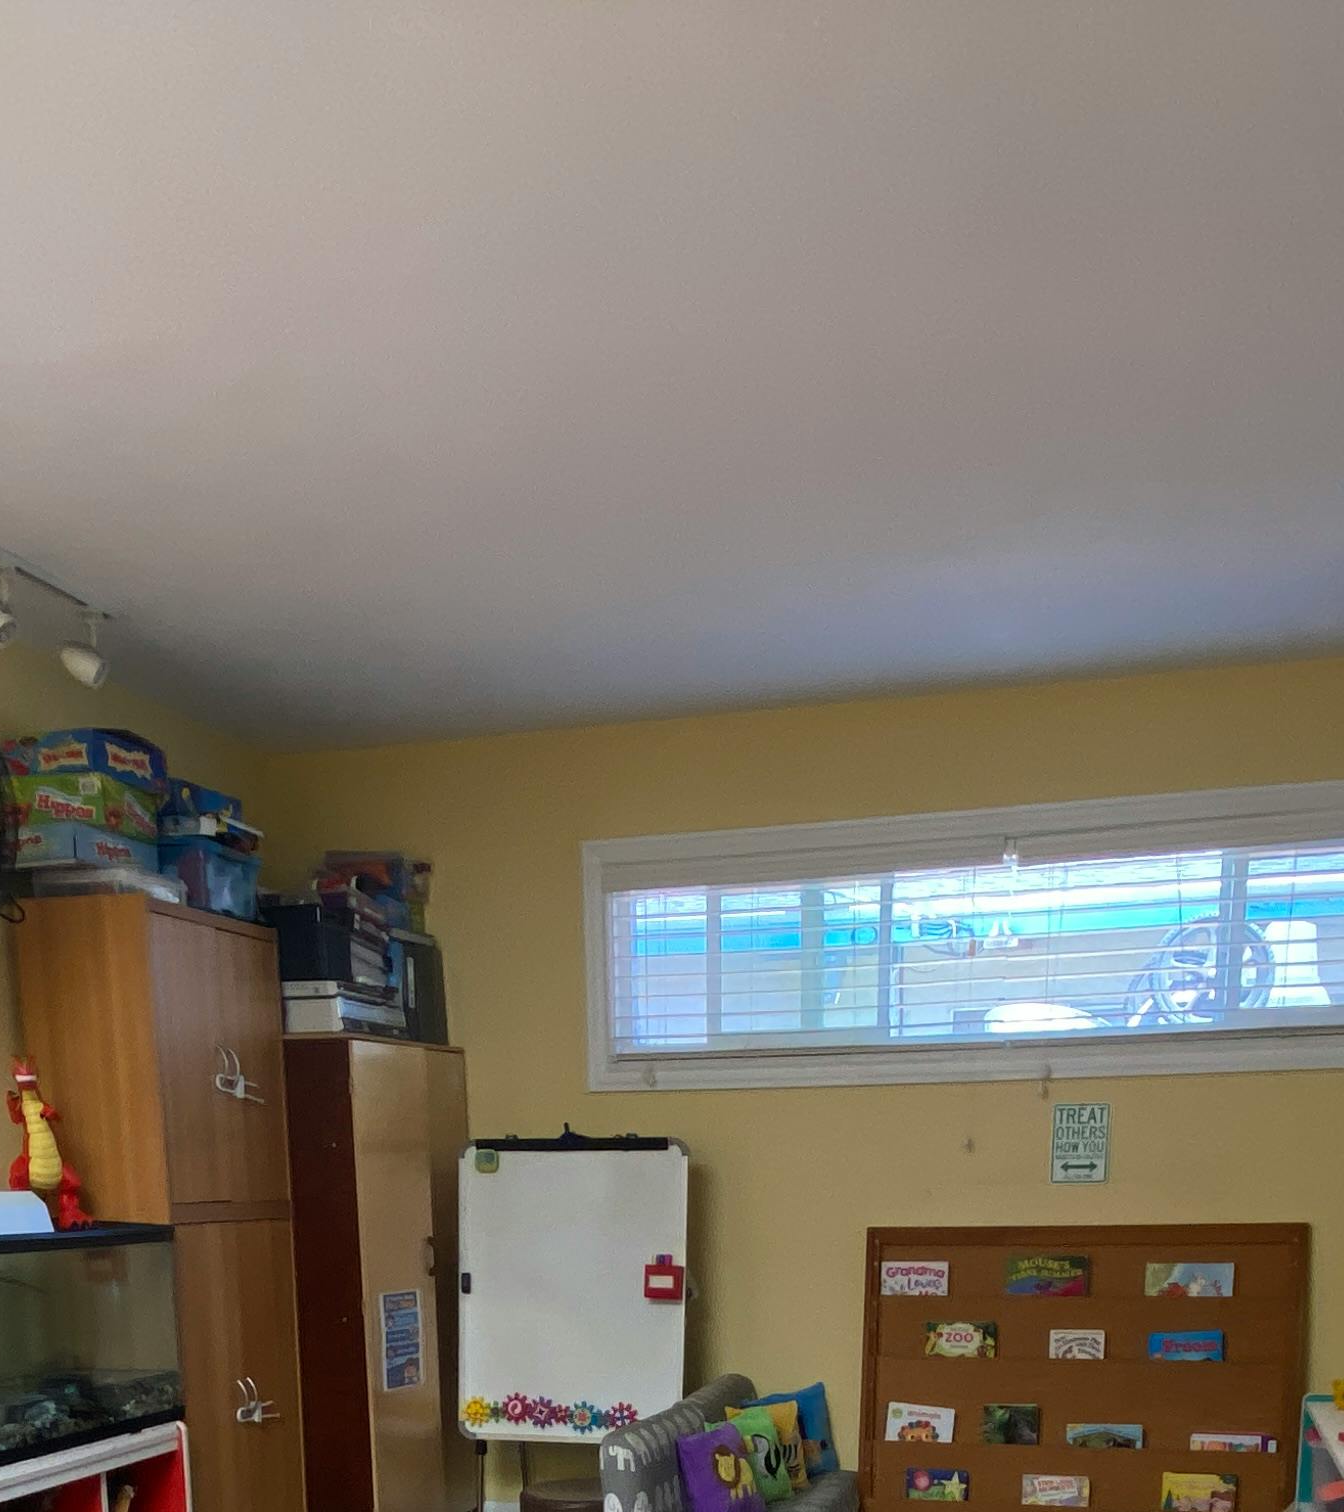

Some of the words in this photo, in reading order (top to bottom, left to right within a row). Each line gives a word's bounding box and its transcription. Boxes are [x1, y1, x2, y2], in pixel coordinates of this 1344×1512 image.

[1057, 1106, 1106, 1125] TREAT
[1056, 1126, 1106, 1141] OTHERS
[1055, 1141, 1079, 1153] HOW
[1081, 1141, 1105, 1153] YOU
[885, 1265, 946, 1280] Grandma
[945, 1332, 975, 1343] ZOO
